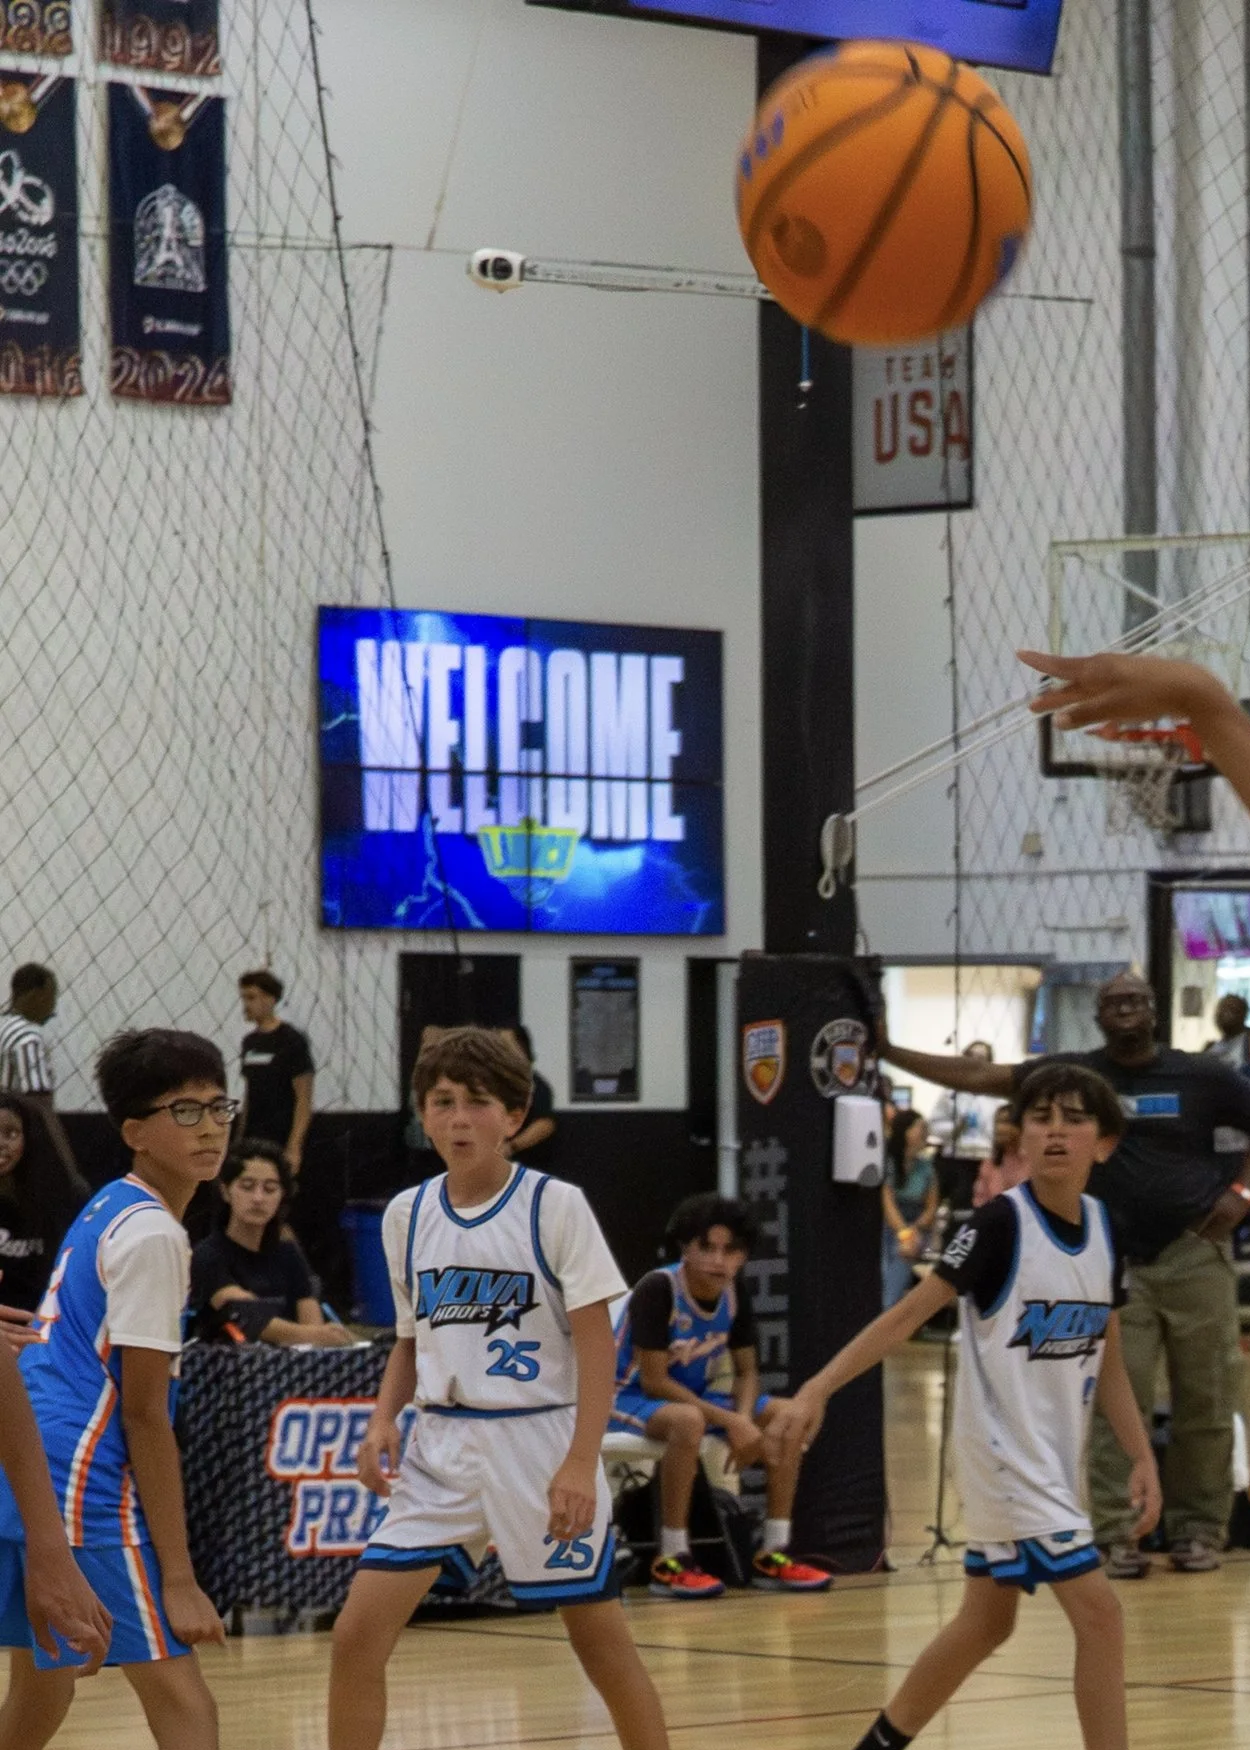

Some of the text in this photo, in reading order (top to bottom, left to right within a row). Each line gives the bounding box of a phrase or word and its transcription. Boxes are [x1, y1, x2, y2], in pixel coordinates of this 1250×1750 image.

[873, 390, 970, 464] USA
[355, 638, 685, 842] WELCOME
[417, 1269, 529, 1319] NOVA
[432, 1304, 491, 1322] HOOPS
[485, 1338, 542, 1382] 25
[542, 1527, 595, 1572] 25
